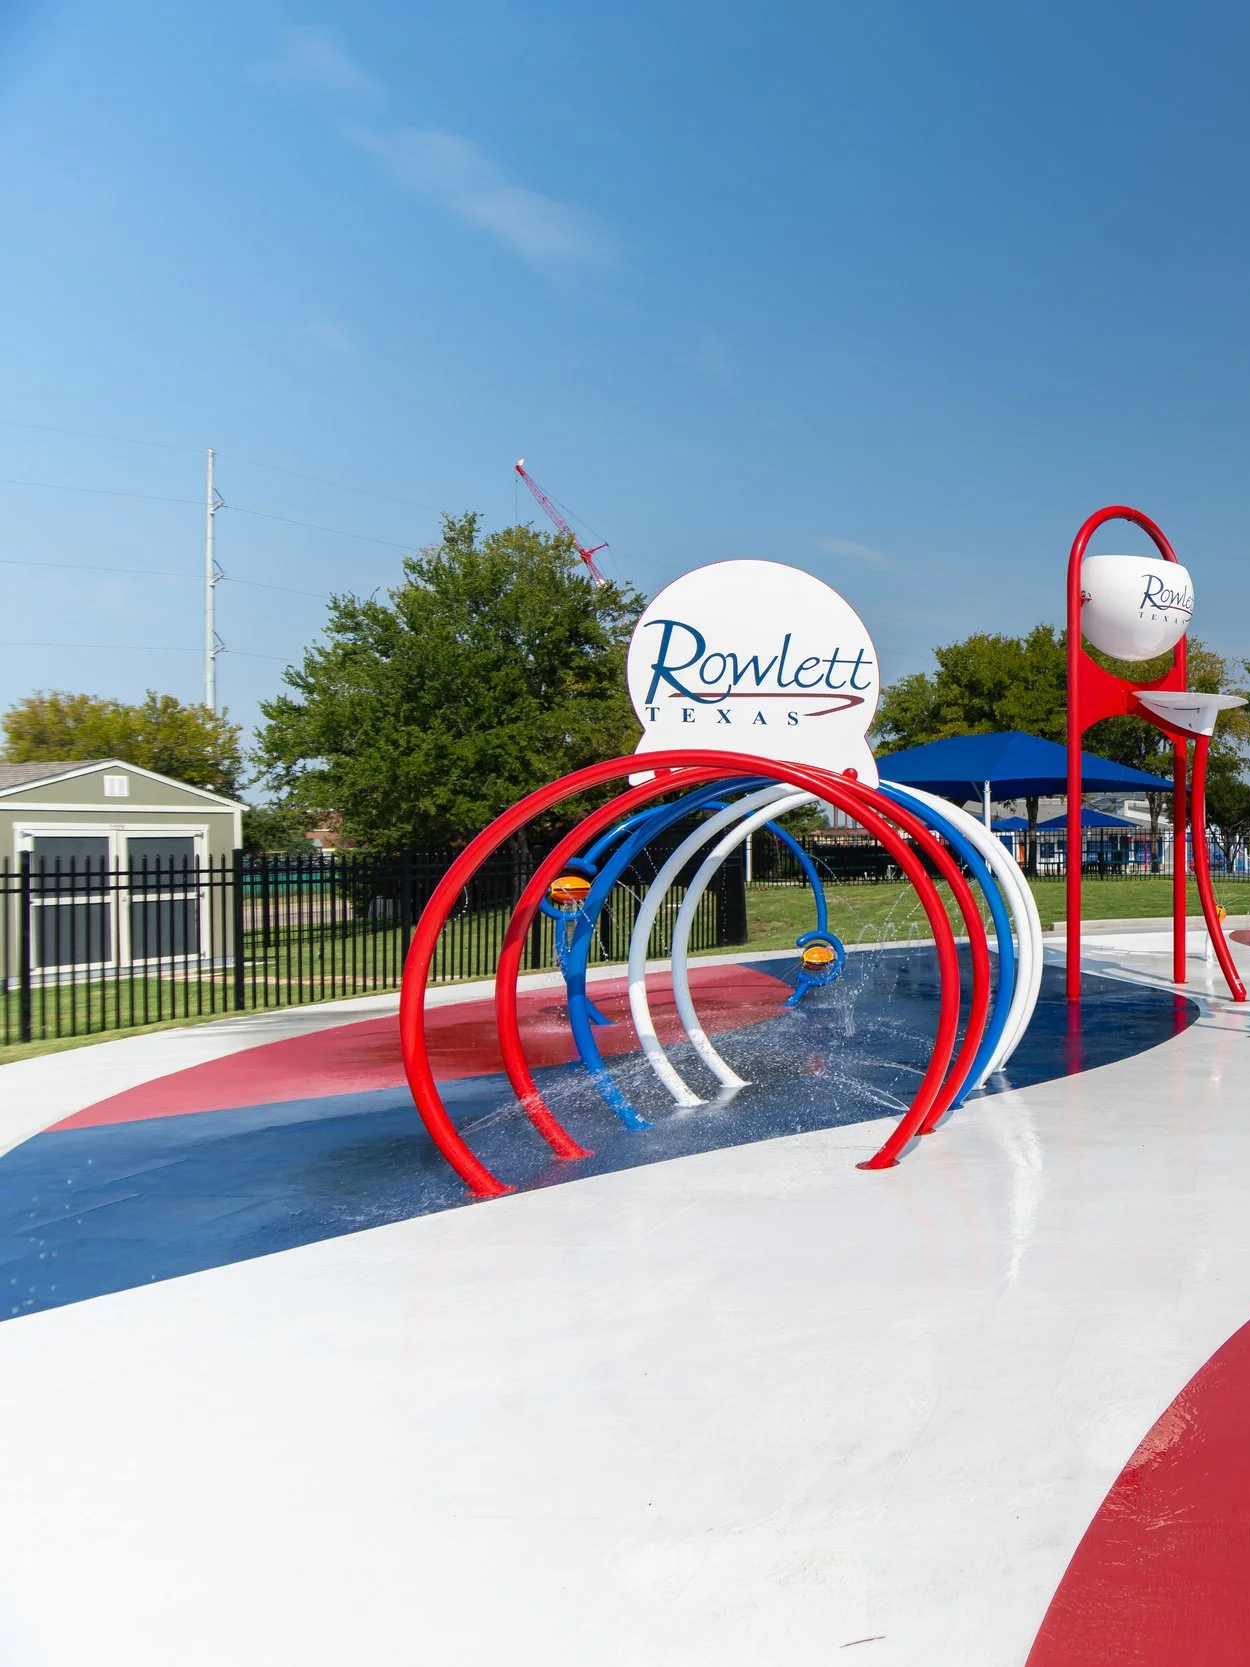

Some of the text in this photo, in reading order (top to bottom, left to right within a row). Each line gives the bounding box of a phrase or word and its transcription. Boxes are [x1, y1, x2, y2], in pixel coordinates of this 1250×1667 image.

[1139, 574, 1194, 611] Rowle
[1139, 612, 1185, 624] TEXAS
[644, 619, 873, 704] Rowlett
[645, 706, 799, 726] TEXAS
